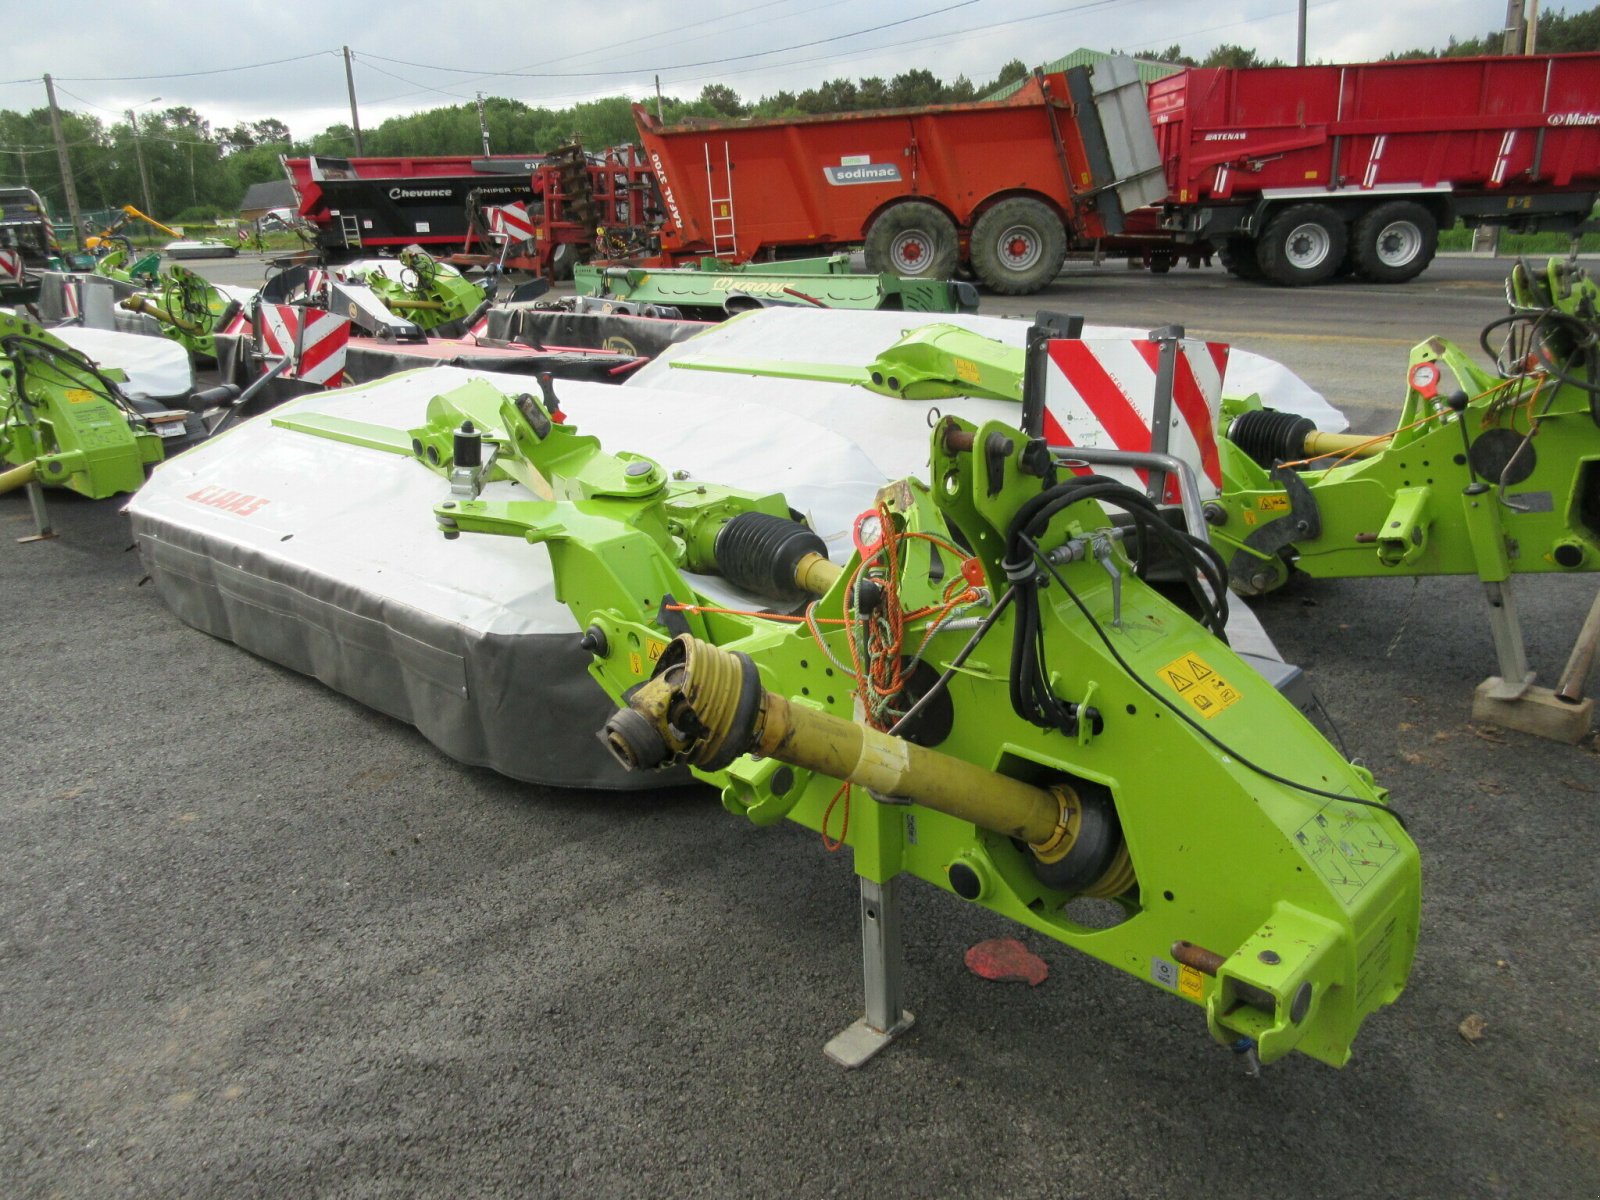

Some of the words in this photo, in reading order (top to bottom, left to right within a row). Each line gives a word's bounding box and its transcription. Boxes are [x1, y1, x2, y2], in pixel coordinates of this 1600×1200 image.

[1565, 112, 1600, 126] Maitr
[651, 154, 667, 184] 3700
[836, 168, 896, 180] sodimac
[389, 187, 452, 200] Chevance
[664, 187, 683, 228] RAFAL
